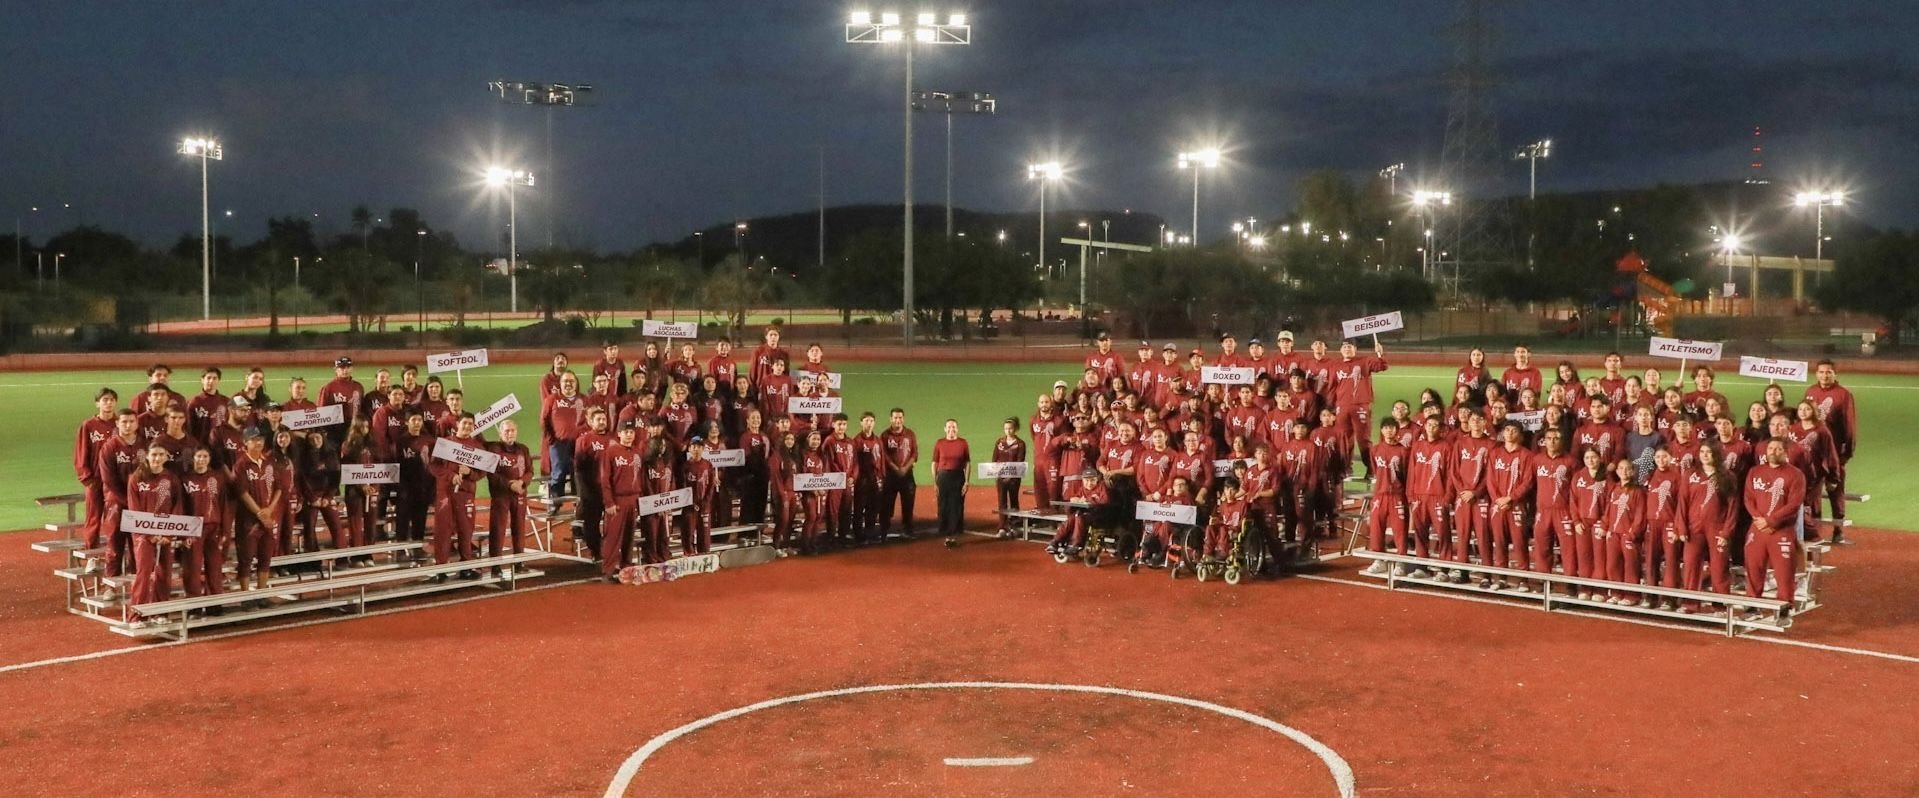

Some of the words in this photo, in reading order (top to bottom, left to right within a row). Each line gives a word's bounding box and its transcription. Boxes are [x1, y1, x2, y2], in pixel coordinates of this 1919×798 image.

[1354, 318, 1391, 332] BEISBOL
[1659, 344, 1713, 355] ATLETISMO
[437, 355, 479, 367] SOFTBOL
[1750, 364, 1797, 376] AJEDREZ
[1213, 372, 1241, 380] BOXEO
[799, 401, 832, 409] KARATE
[293, 416, 332, 427] DEPORTIVO
[473, 402, 515, 431] AEKWONDO
[452, 448, 473, 460] TENIS
[472, 454, 483, 462] DE
[455, 455, 476, 466] MESA
[653, 496, 680, 507] SKATE
[134, 519, 190, 532] VOLEIBOL
